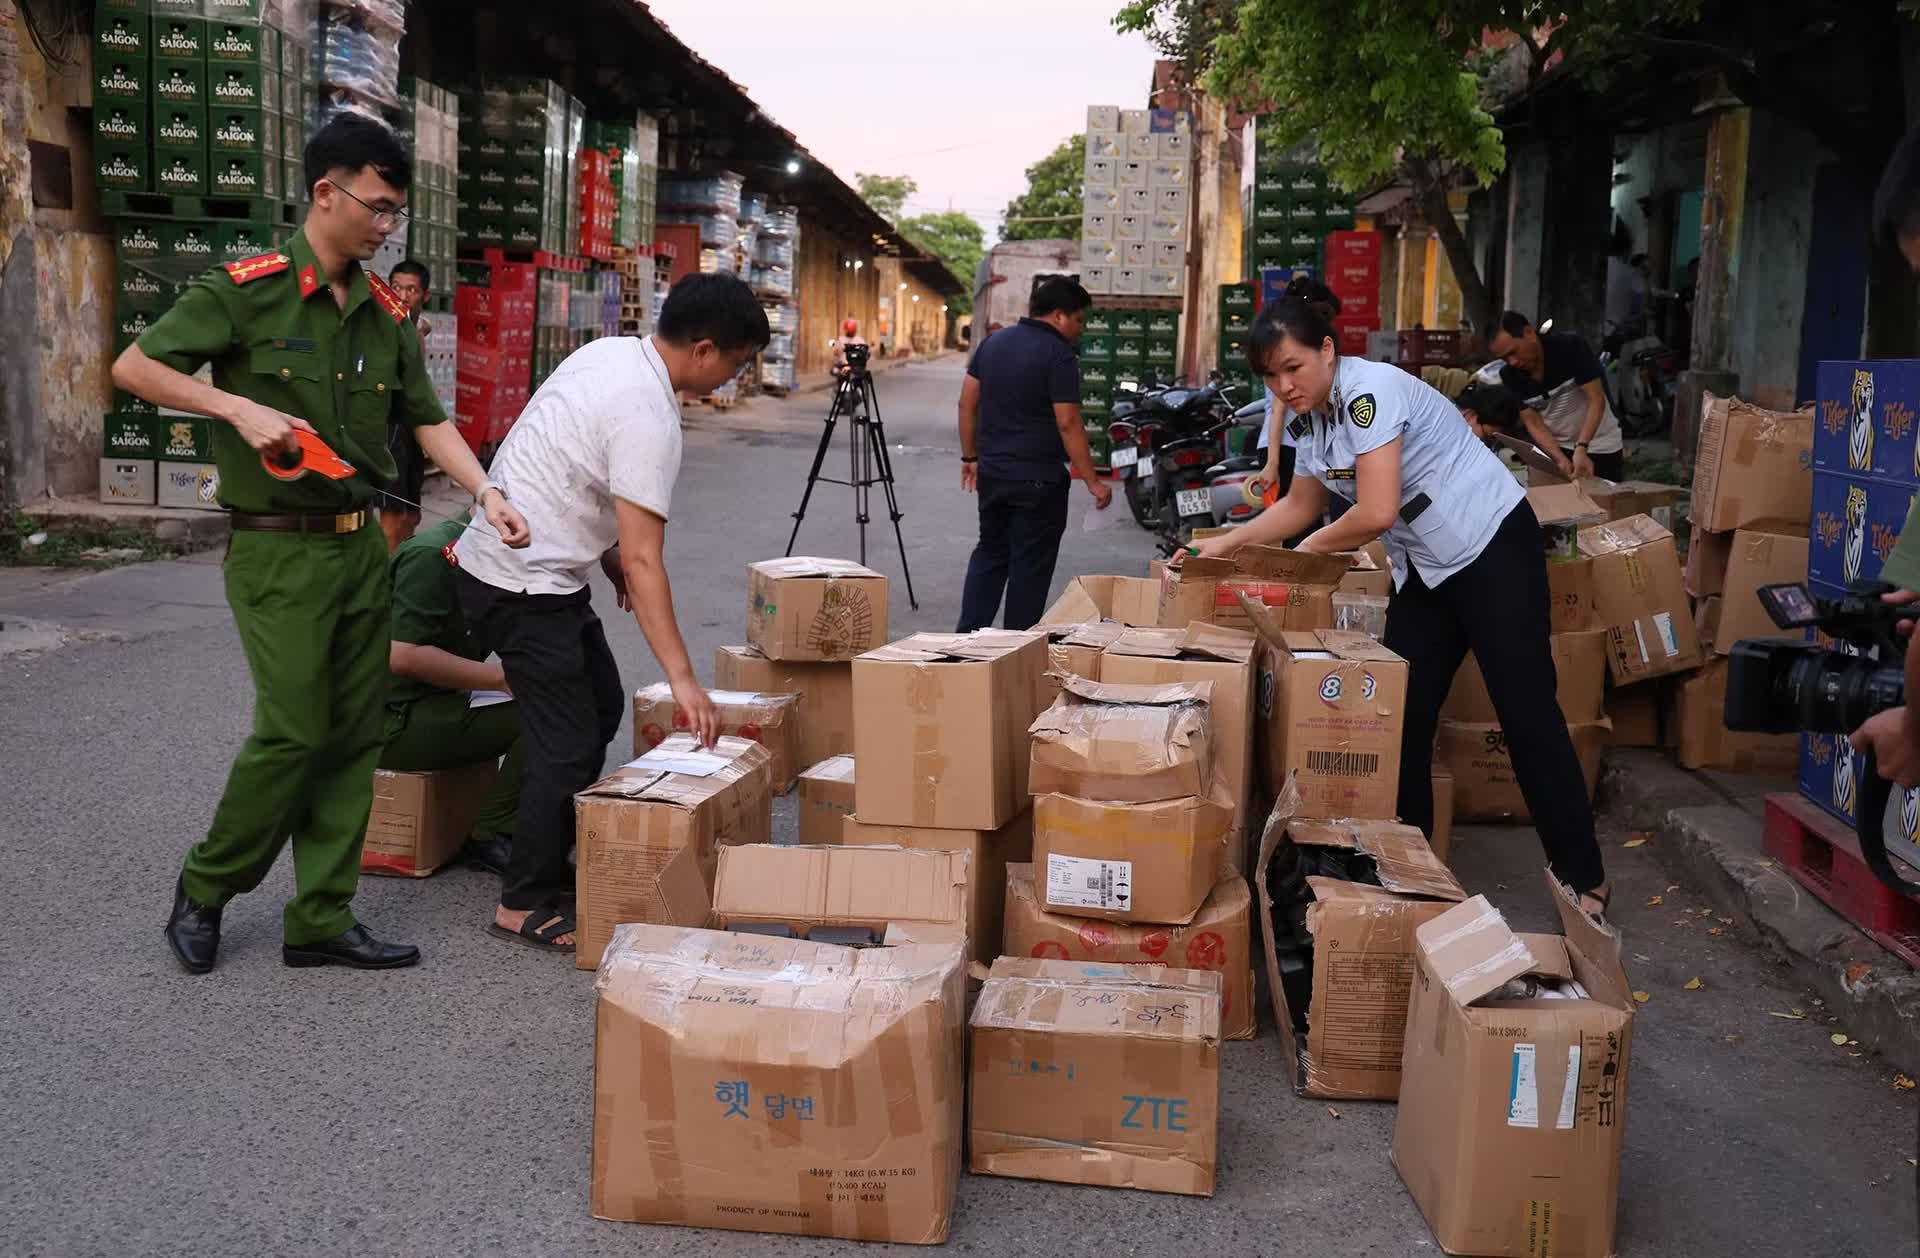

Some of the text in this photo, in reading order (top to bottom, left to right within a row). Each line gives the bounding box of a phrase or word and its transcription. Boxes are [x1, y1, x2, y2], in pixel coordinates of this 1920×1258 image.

[101, 33, 139, 46] SAIGON
[160, 38, 199, 49] SAIGON
[214, 42, 253, 52] SAIGON
[101, 78, 139, 90] SAIGON
[158, 84, 197, 94] SAIGON
[216, 87, 254, 96] SAIGON
[99, 123, 138, 134] SAIGON
[160, 128, 199, 138] SAIGON
[216, 131, 255, 141] SAIGON
[101, 166, 139, 177] SAIGON
[161, 172, 199, 182] SAIGON
[217, 174, 256, 185] SAIGON
[122, 239, 158, 249] SAIGON
[174, 244, 210, 253] SAIGON
[225, 244, 262, 254] SAIGON
[123, 282, 160, 293] SAIGON
[122, 324, 150, 333] SAIG
[1822, 400, 1848, 435] Tiger
[1884, 403, 1914, 440] Tiger
[112, 436, 150, 446] SAIGON
[166, 446, 196, 456] SAIGON
[170, 472, 197, 486] Tiger
[1817, 512, 1842, 547] Tiger
[714, 1080, 815, 1120] 햇 당면
[1120, 1096, 1188, 1132] ZTE
[716, 1204, 755, 1214] PRODUCT
